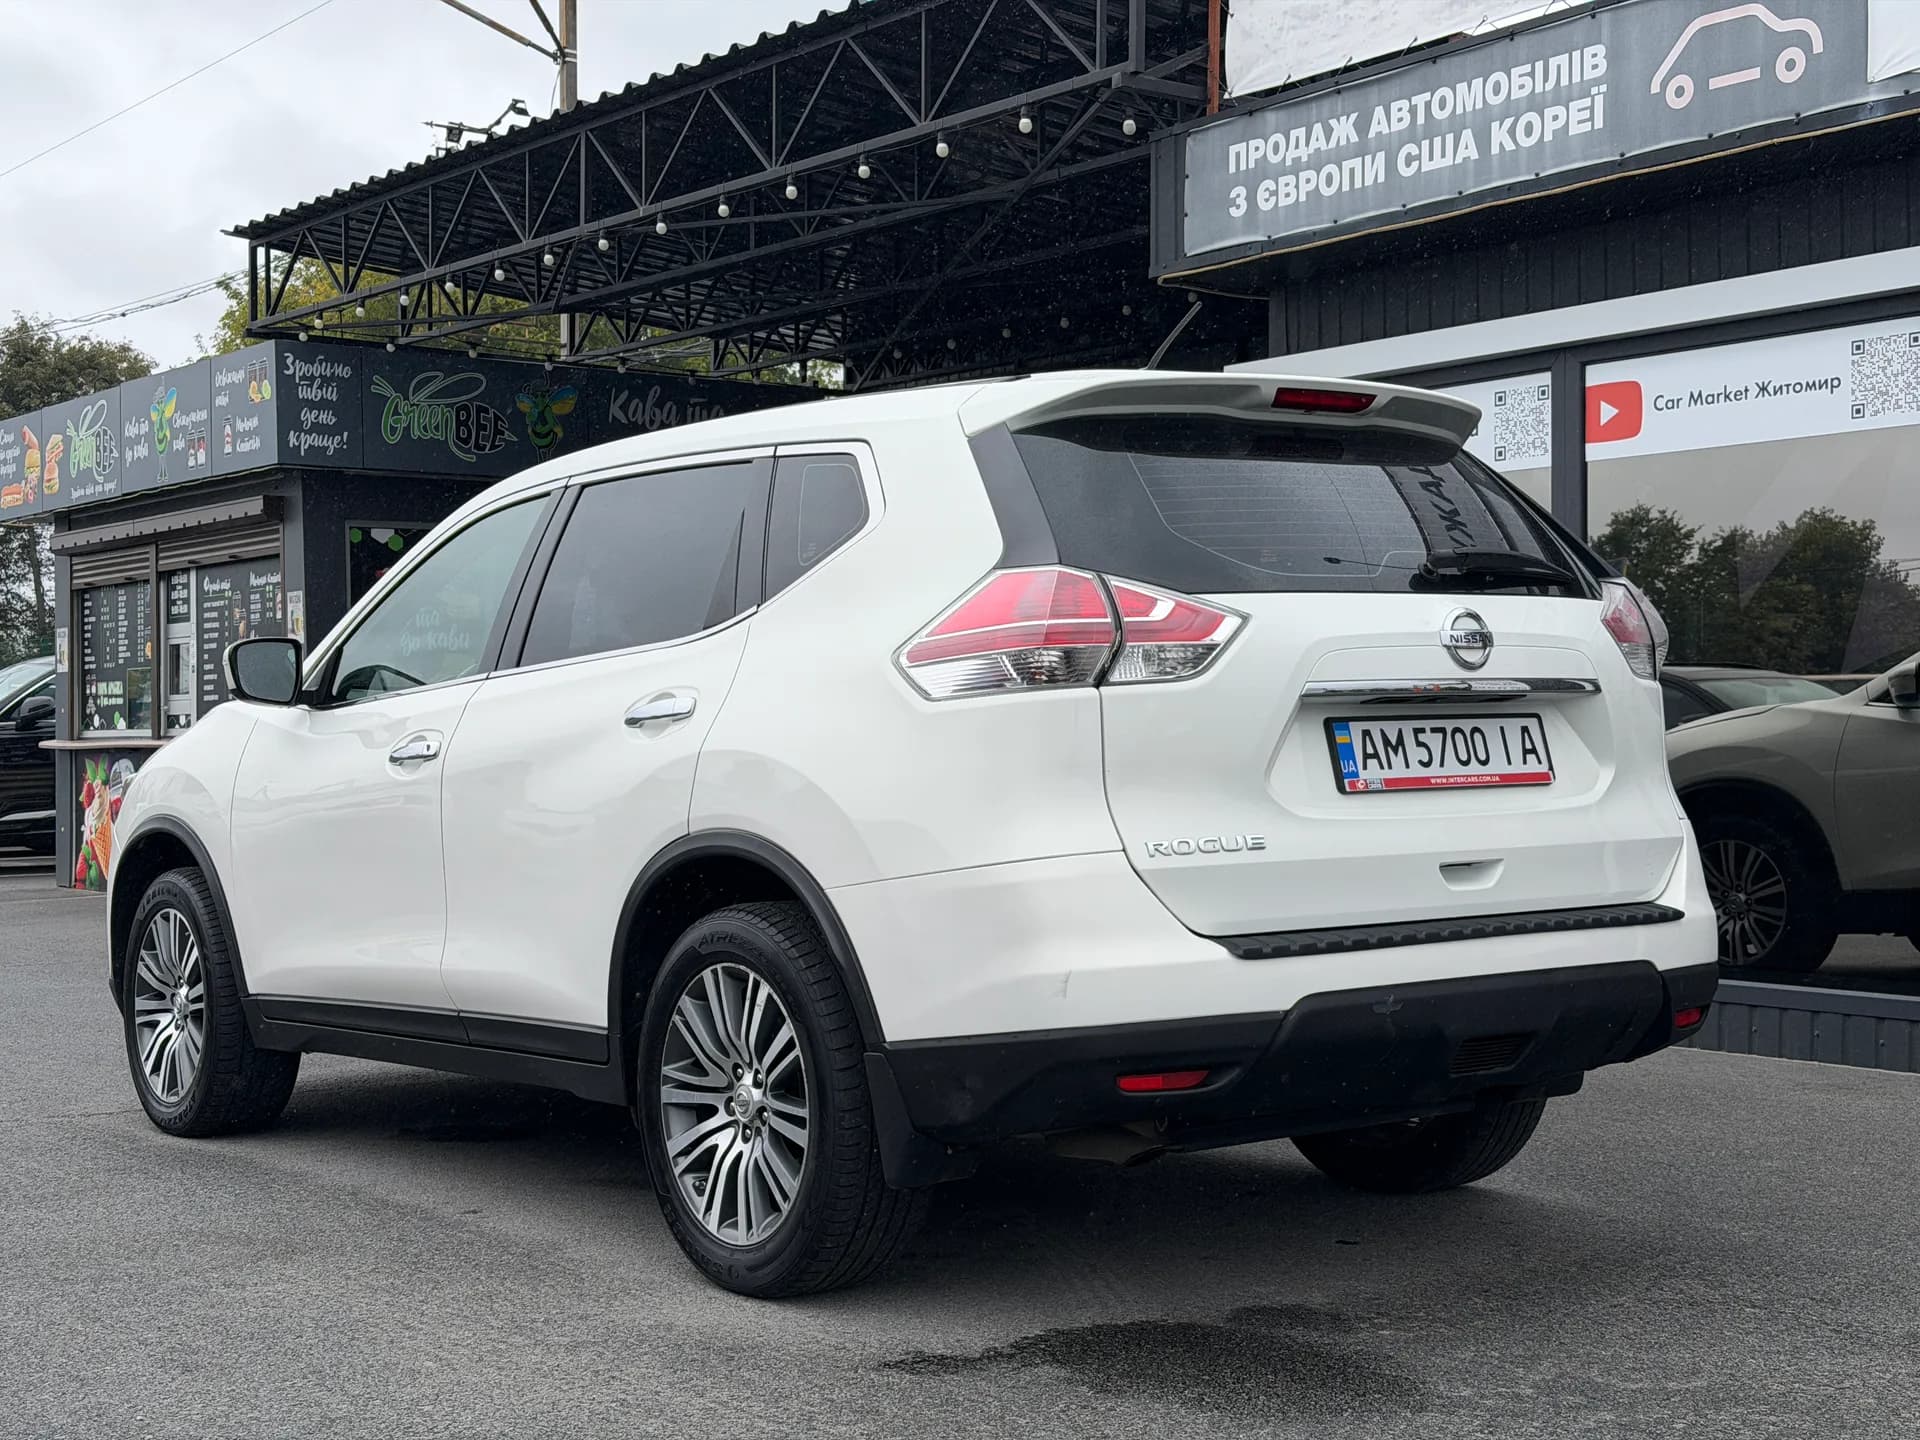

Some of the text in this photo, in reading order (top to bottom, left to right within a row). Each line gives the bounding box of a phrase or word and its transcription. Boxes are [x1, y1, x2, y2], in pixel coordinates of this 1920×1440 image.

[1228, 43, 1608, 174] ПРОДАЖ АВТОМОБІЛІВ
[1228, 84, 1608, 217] З ЄВРОПИ США КОРЕЇ
[283, 352, 353, 383] Зробимо
[298, 378, 340, 402] твій
[1653, 375, 1842, 412] Car Market Житомир
[300, 407, 337, 430] день
[608, 385, 680, 430] Кава
[287, 430, 349, 457] краще!
[1449, 633, 1492, 645] NISSAN
[1342, 758, 1358, 774] UA
[1144, 834, 1267, 858] ROGUE
